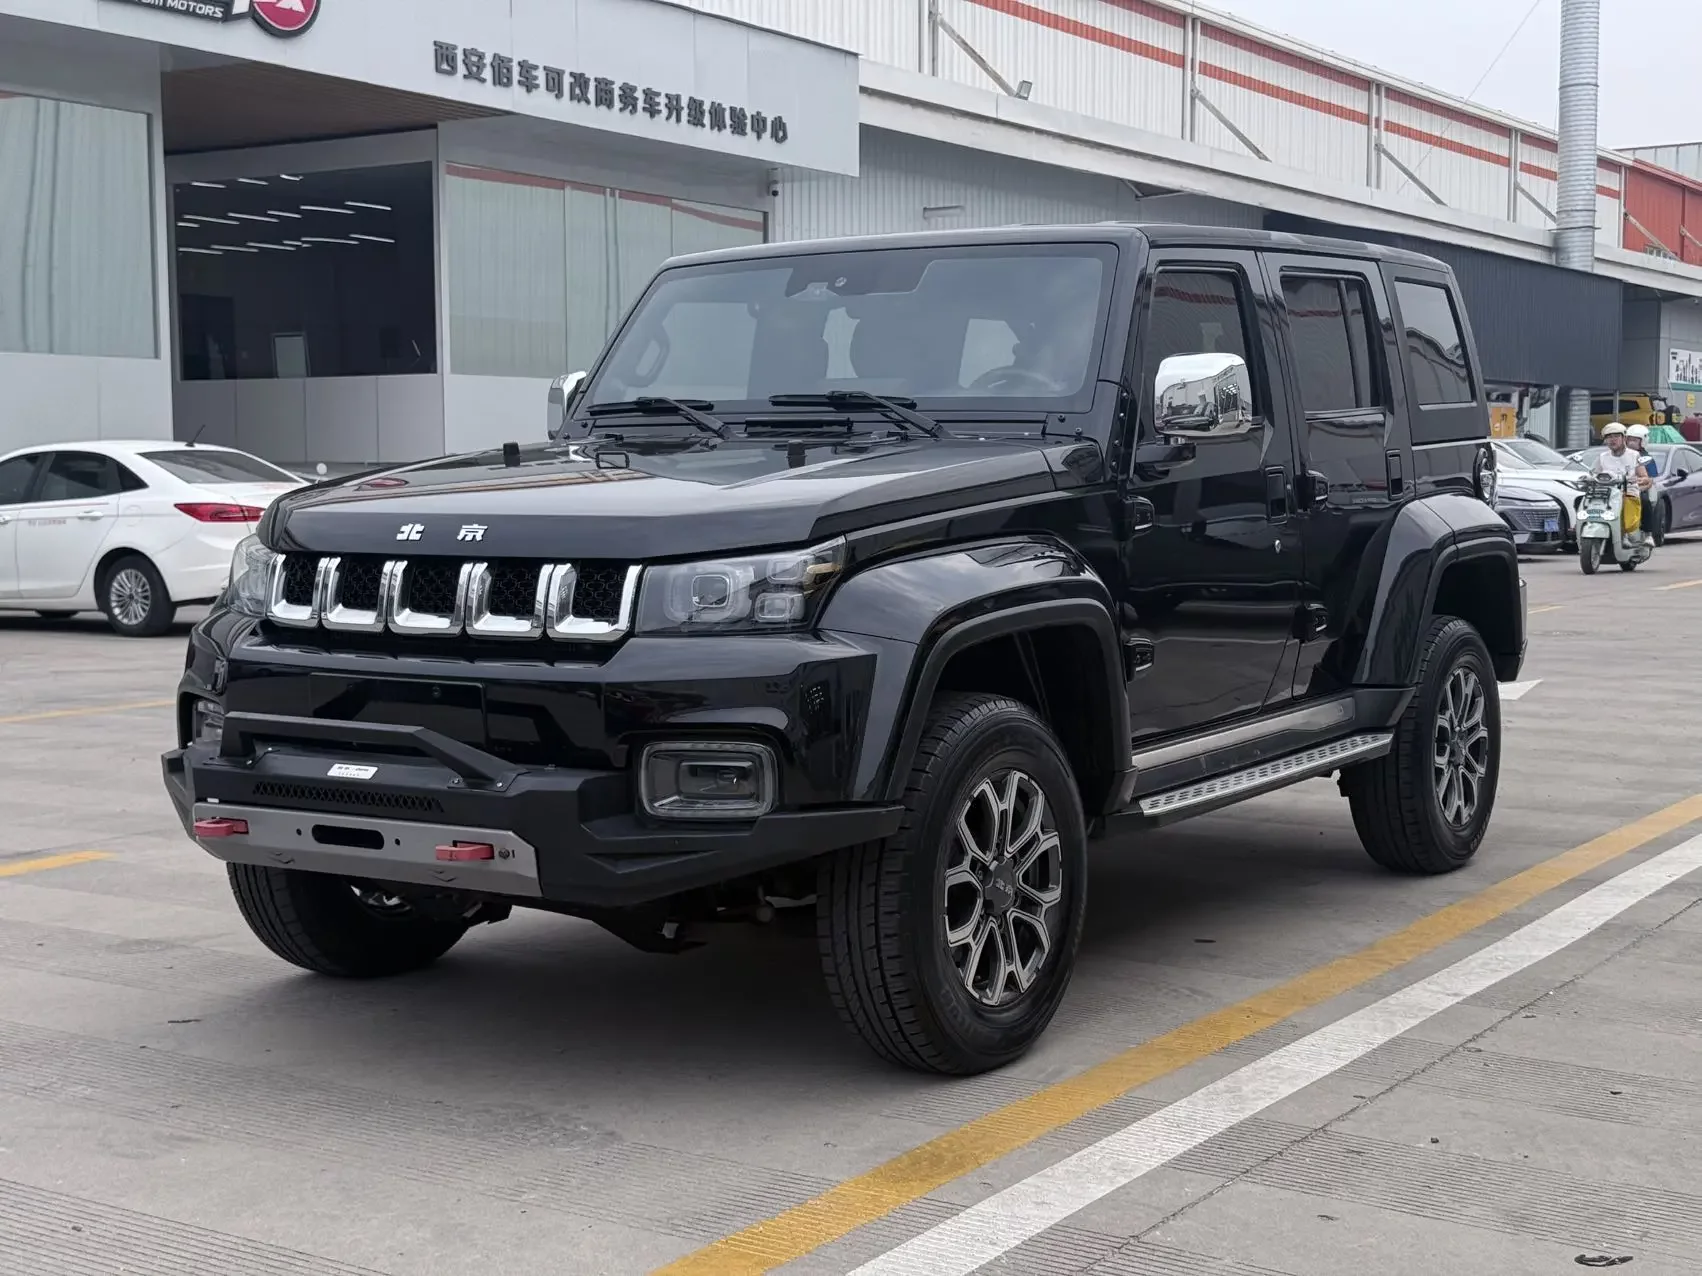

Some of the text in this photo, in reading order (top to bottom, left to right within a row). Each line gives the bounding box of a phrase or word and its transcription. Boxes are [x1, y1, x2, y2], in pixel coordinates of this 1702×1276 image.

[166, 0, 224, 18] MOTORS
[433, 40, 789, 144] 西安佰车可改商务车升级体验中心
[396, 523, 488, 542] 北京
